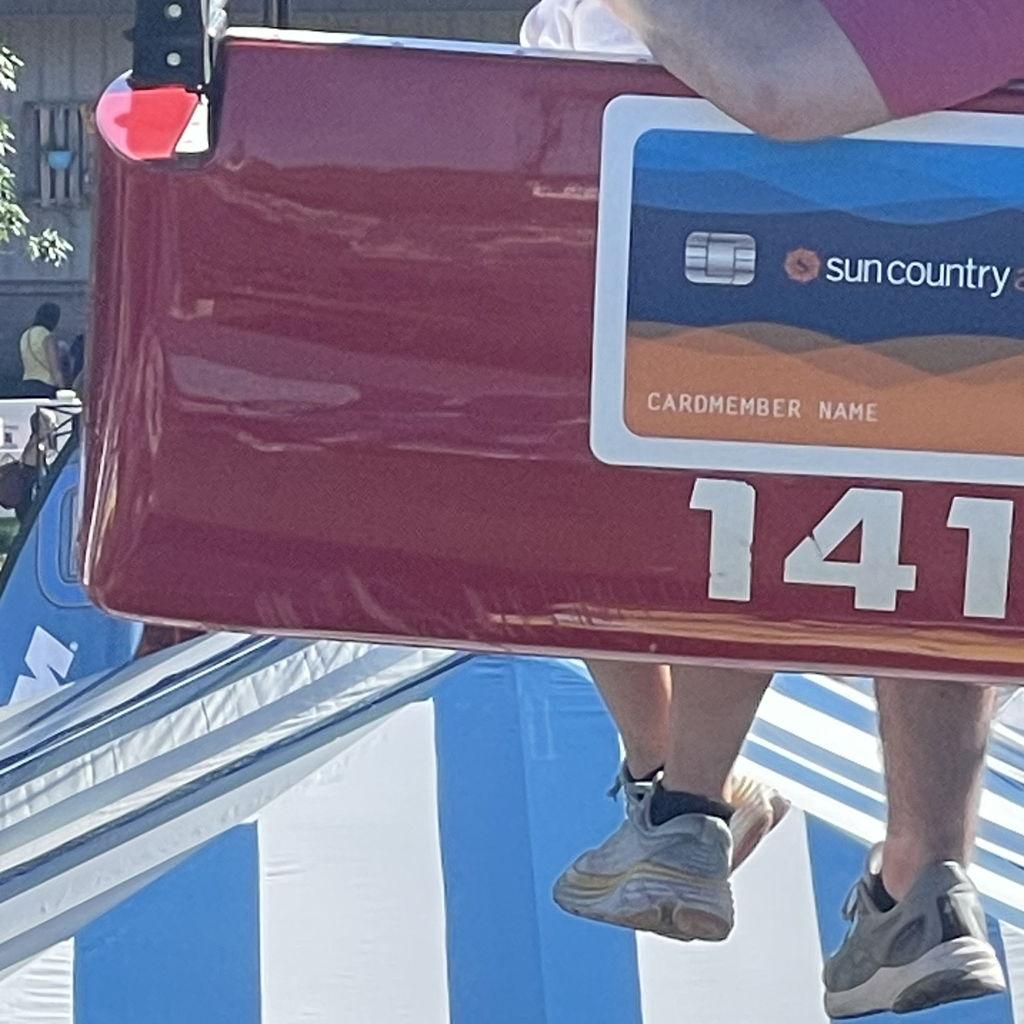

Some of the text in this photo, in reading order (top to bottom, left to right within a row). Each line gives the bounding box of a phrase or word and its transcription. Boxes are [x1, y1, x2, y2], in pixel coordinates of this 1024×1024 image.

[648, 392, 878, 422] CARDMEMBER NAME
[689, 477, 1014, 619] 141
